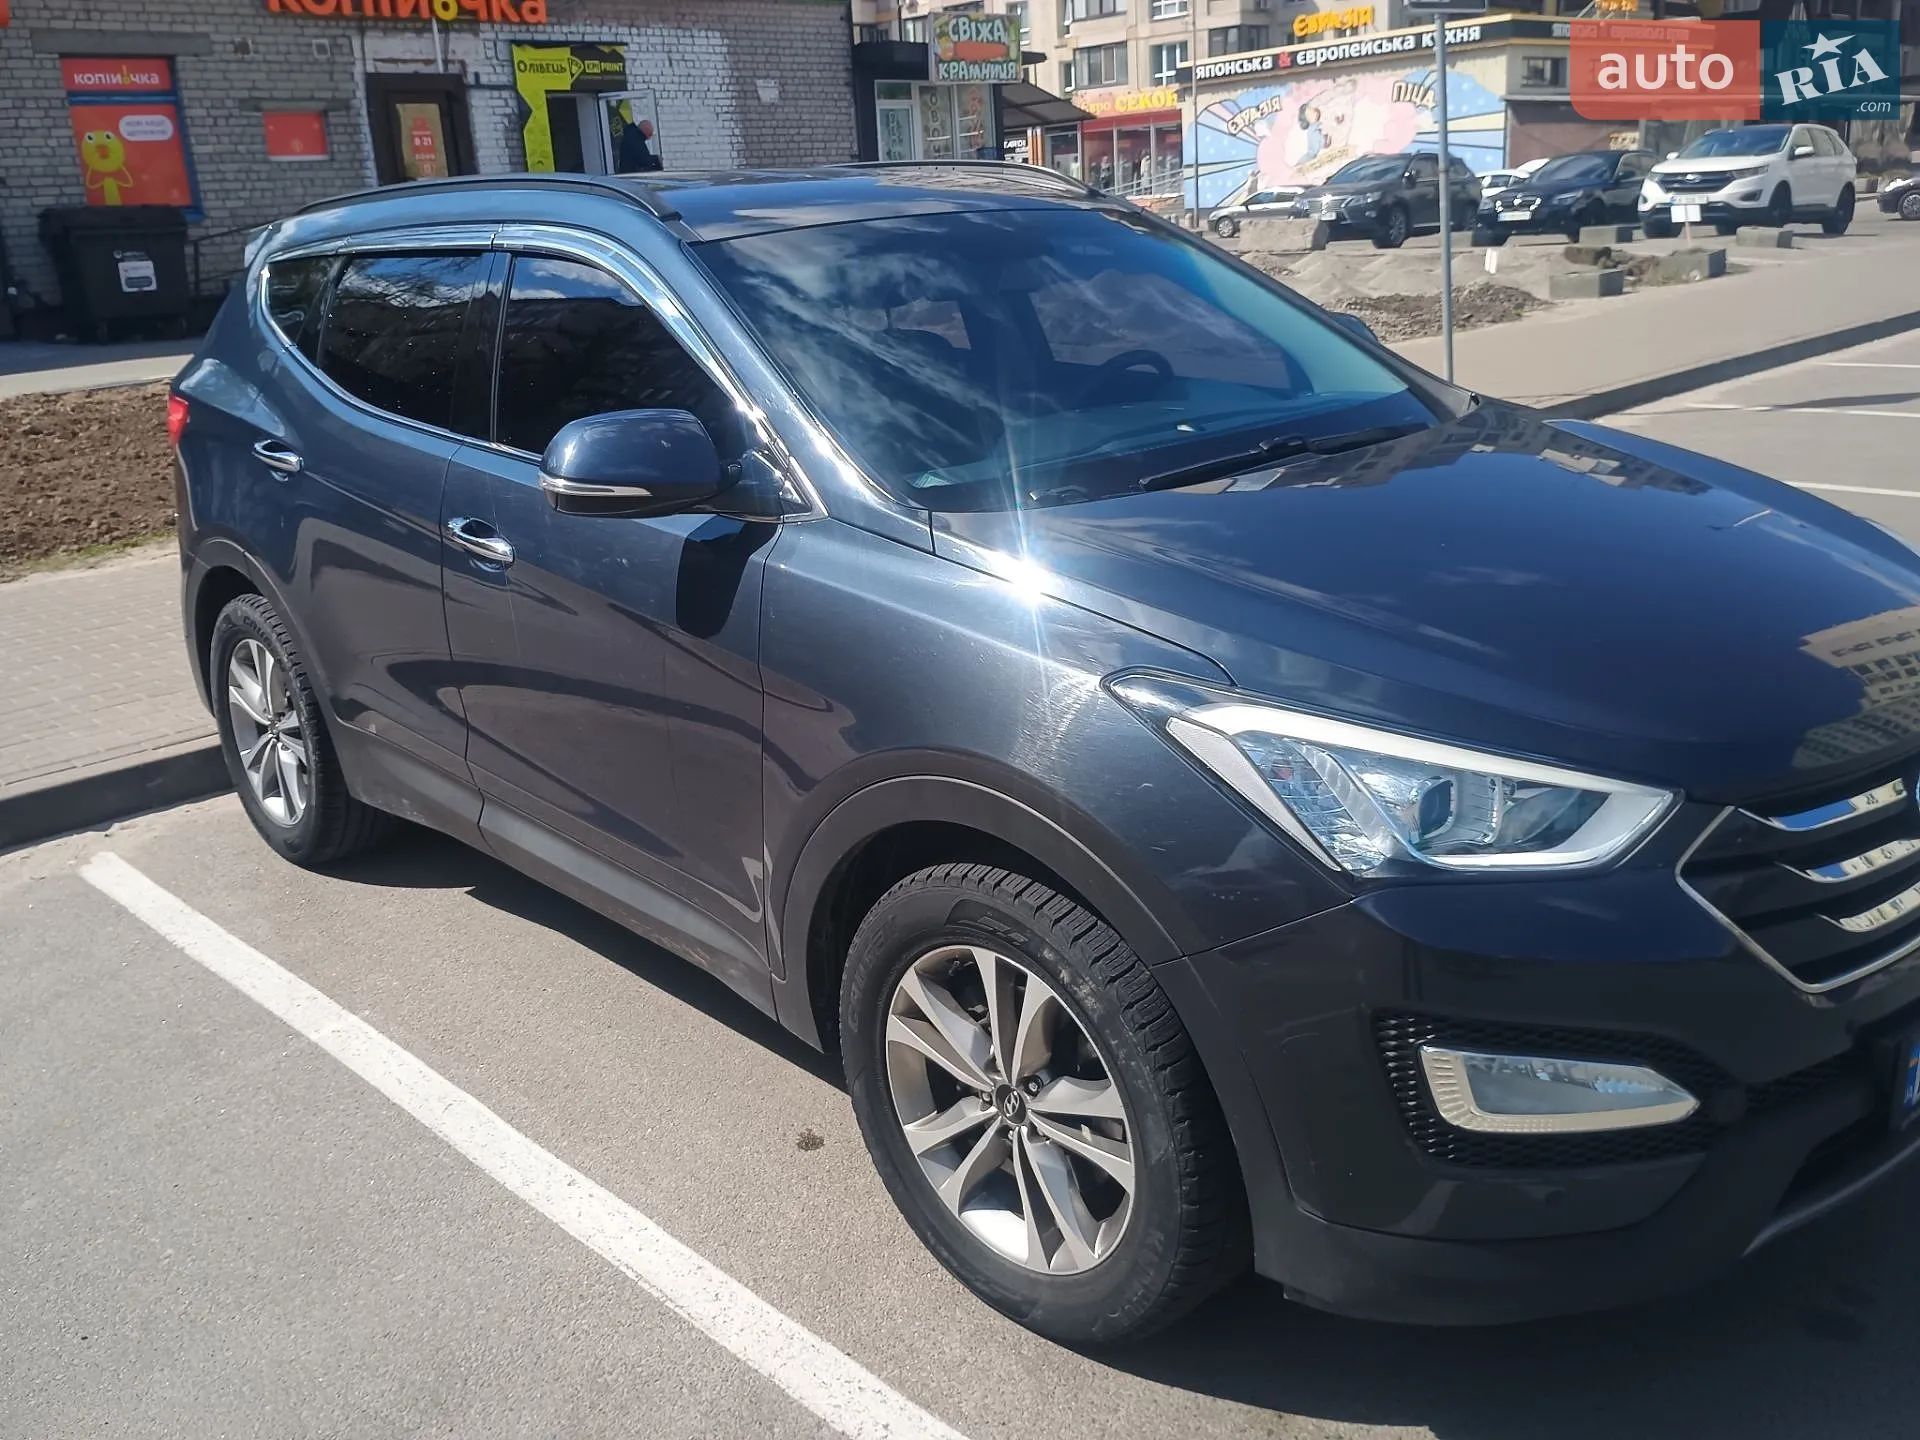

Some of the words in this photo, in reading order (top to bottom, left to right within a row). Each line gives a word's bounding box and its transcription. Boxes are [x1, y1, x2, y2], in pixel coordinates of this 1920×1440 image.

[949, 17, 1009, 44] СВІЖА
[938, 61, 1016, 80] КРАМНИЦЯ
[1196, 55, 1273, 79] японська
[1392, 82, 1437, 109] ПІЦА
